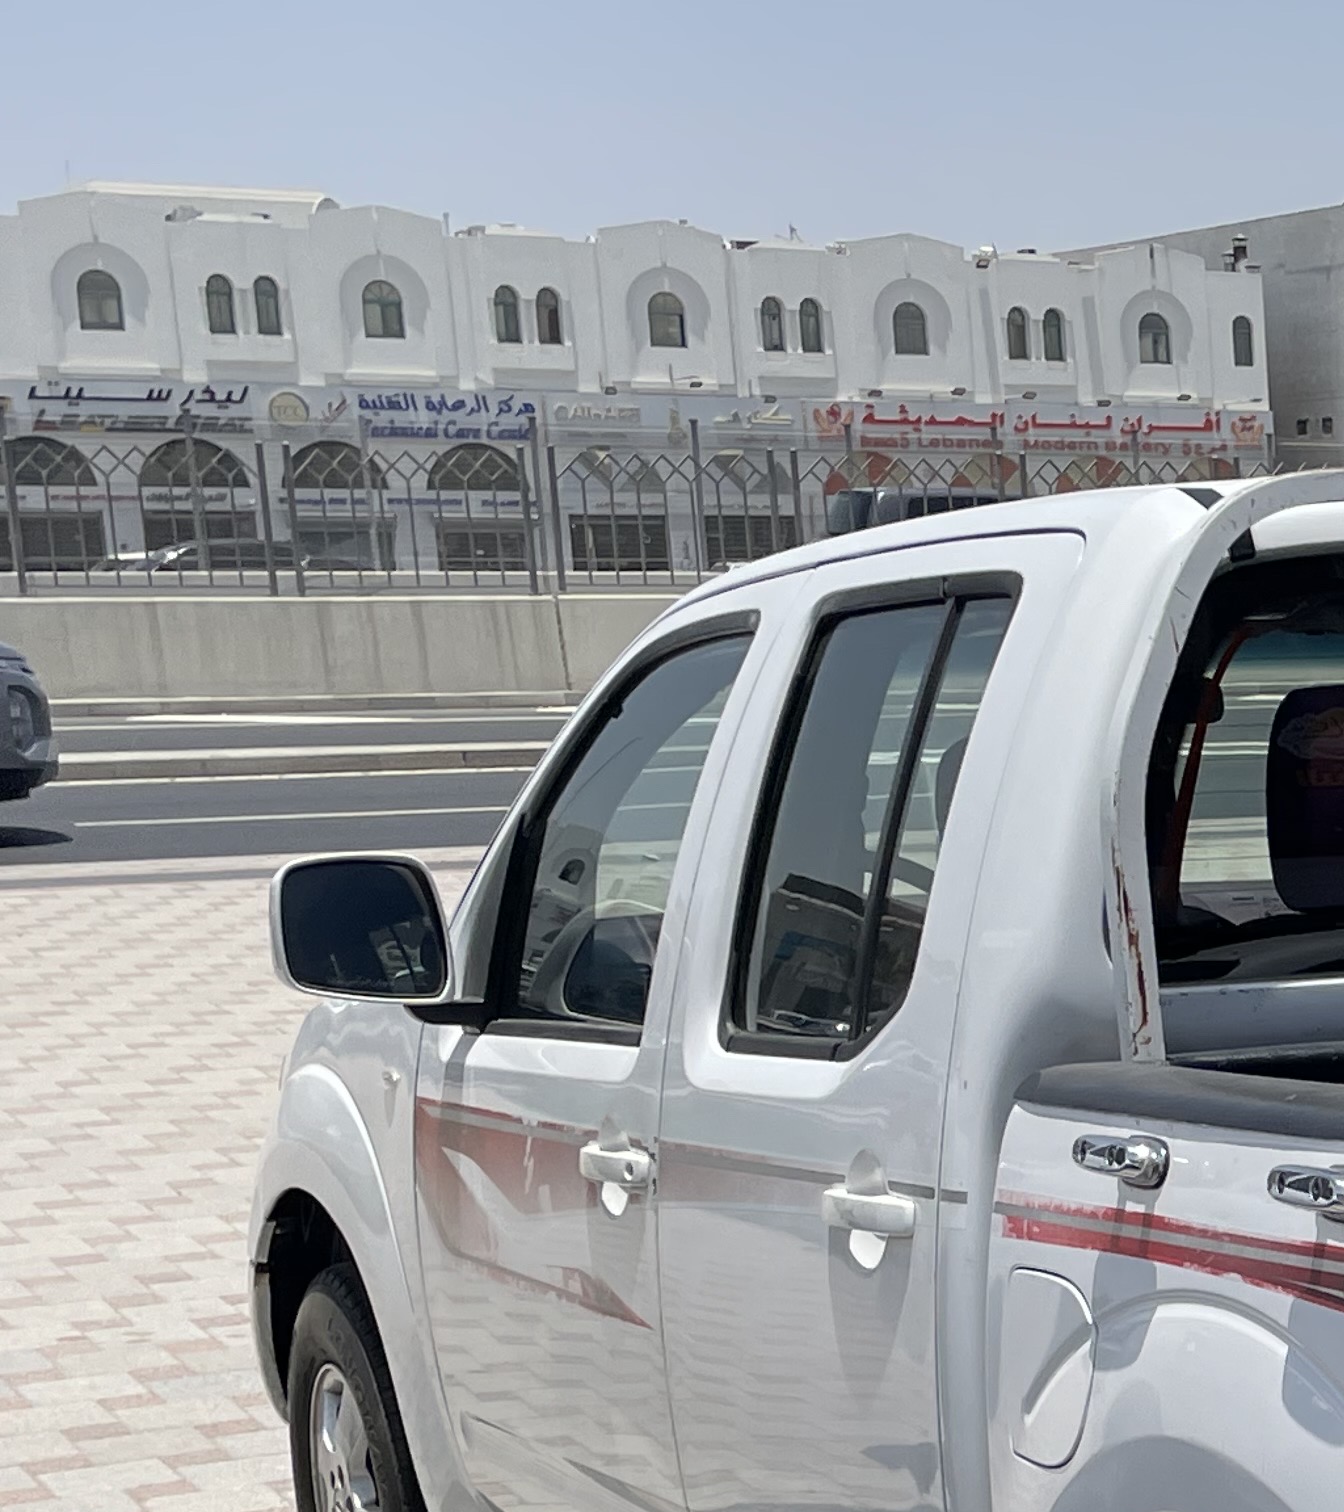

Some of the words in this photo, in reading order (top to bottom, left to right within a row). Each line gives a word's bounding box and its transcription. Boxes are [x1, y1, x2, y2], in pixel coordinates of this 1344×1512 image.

[424, 393, 490, 417] الرعاية
[495, 394, 537, 417] مركز
[861, 403, 1005, 432] الحديثة
[1014, 411, 1113, 436] لبنان
[1120, 410, 1222, 436] أفران
[443, 419, 481, 440] Care
[486, 421, 532, 441] Cente
[1023, 438, 1099, 452] Modern
[1104, 440, 1172, 455] Baery
